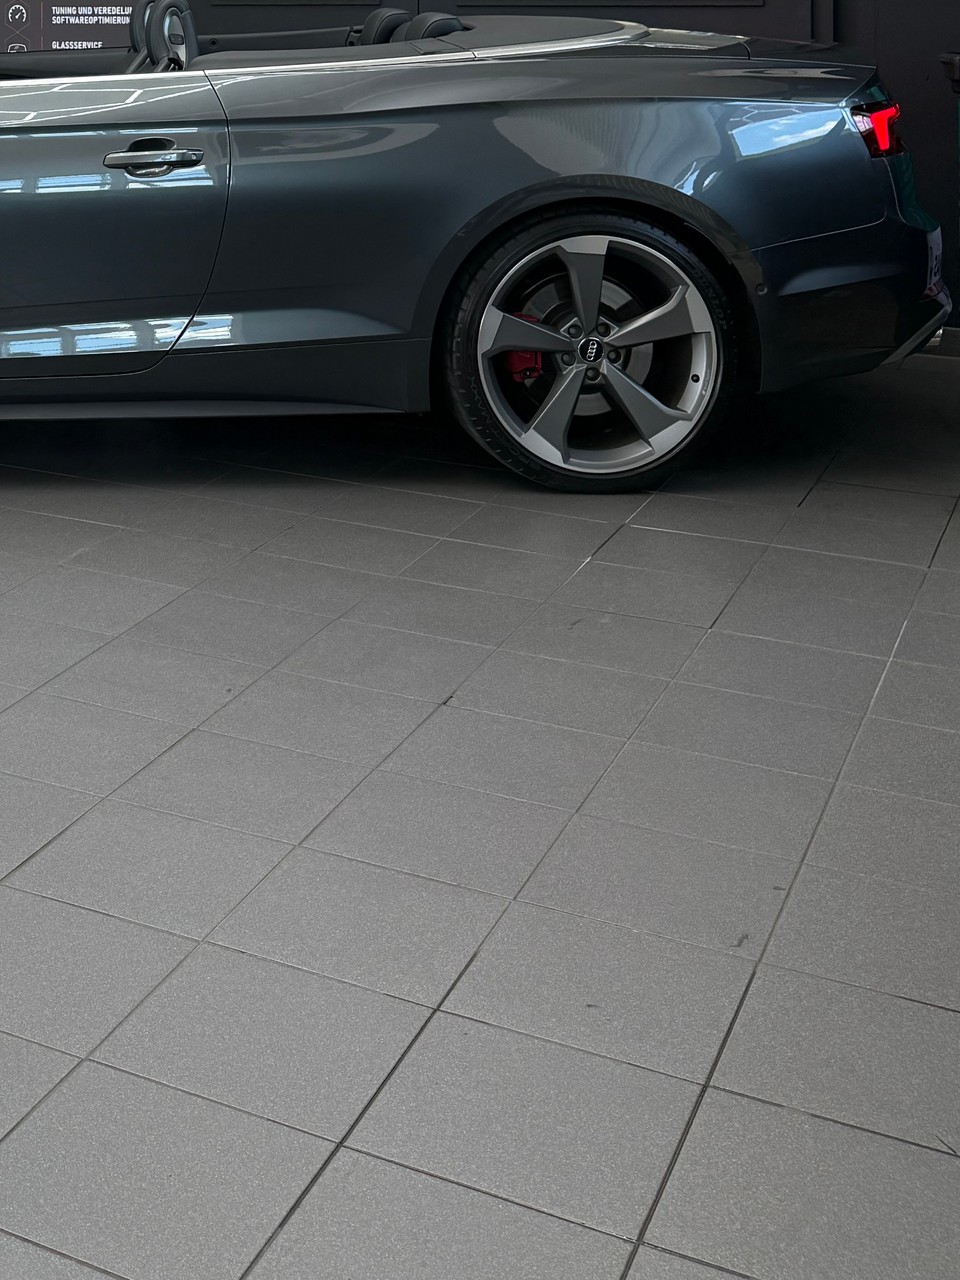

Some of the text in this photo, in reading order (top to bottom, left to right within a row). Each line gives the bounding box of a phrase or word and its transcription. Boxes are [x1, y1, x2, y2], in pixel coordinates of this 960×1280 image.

[51, 6, 77, 15] TUNING
[77, 6, 93, 15] UND
[51, 40, 103, 50] GLASSSERVICE
